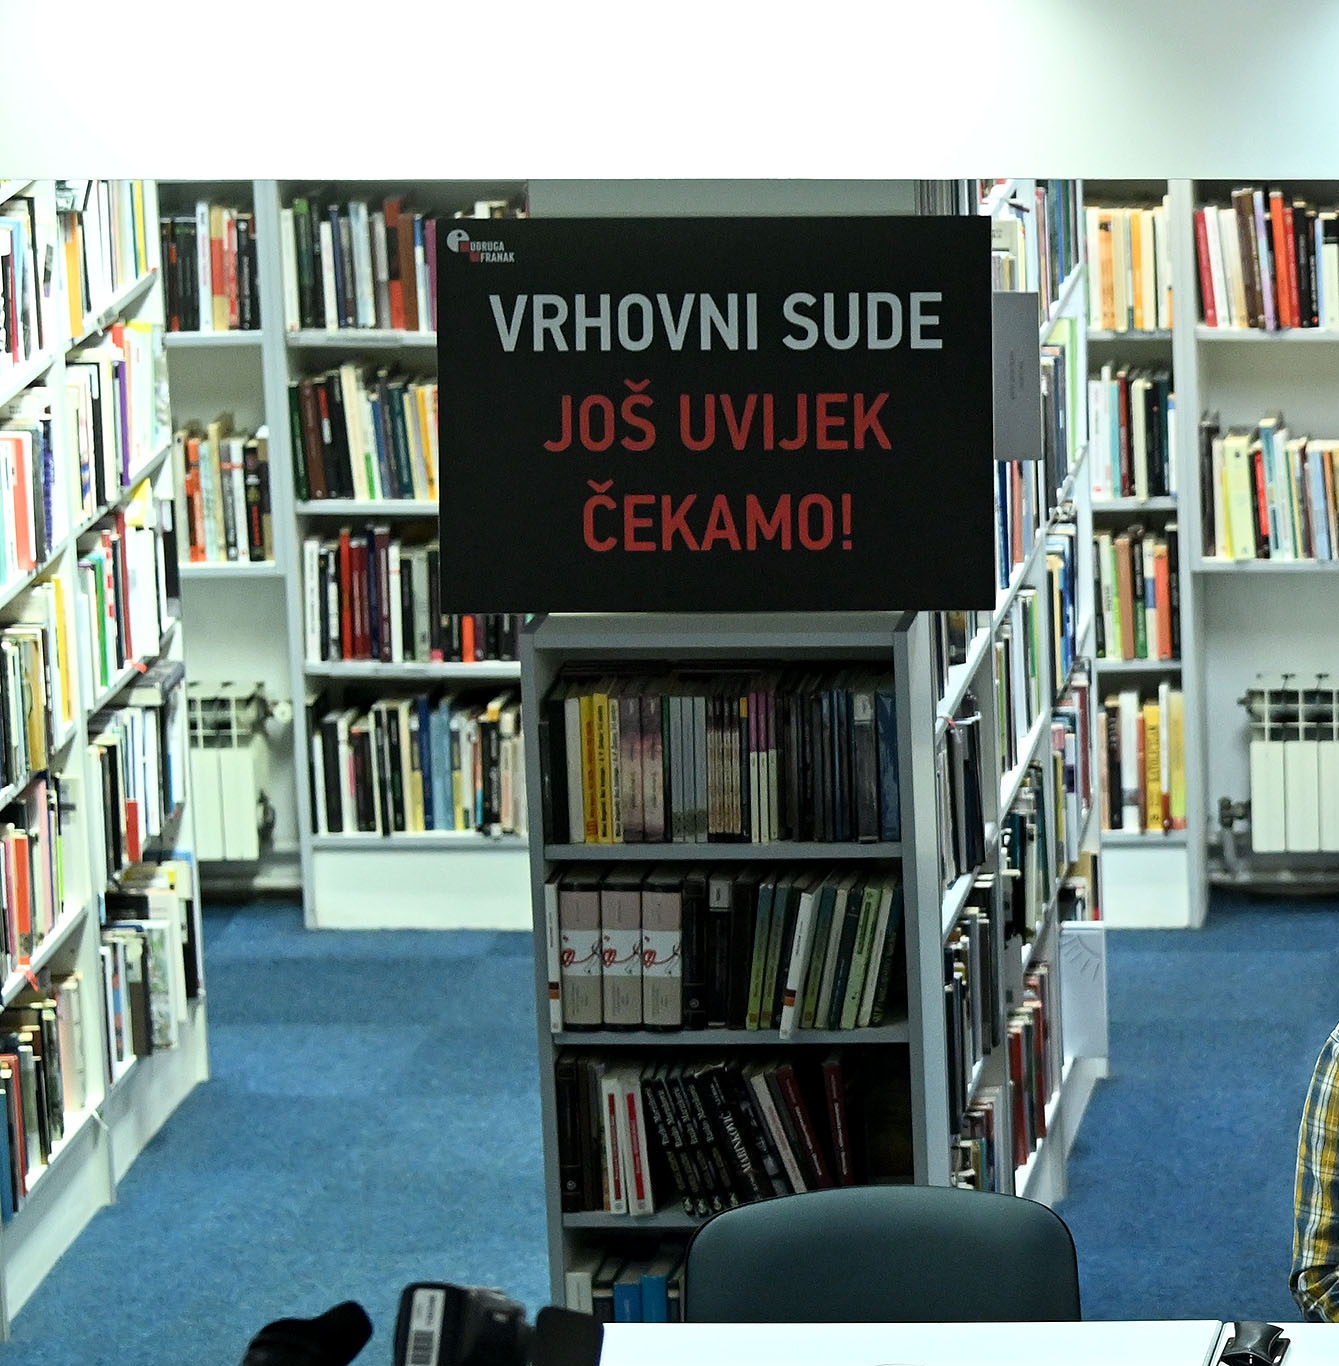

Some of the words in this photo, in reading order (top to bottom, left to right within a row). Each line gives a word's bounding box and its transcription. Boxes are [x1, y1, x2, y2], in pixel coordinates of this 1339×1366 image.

[470, 241, 505, 252] UDRUGA
[480, 251, 515, 263] FRANAK
[489, 292, 759, 352] VRHOVNI
[782, 291, 943, 351] SUDE
[543, 378, 656, 452] JOŠ
[680, 392, 893, 451] UVIJEK
[583, 478, 853, 552] ČEKAMO!
